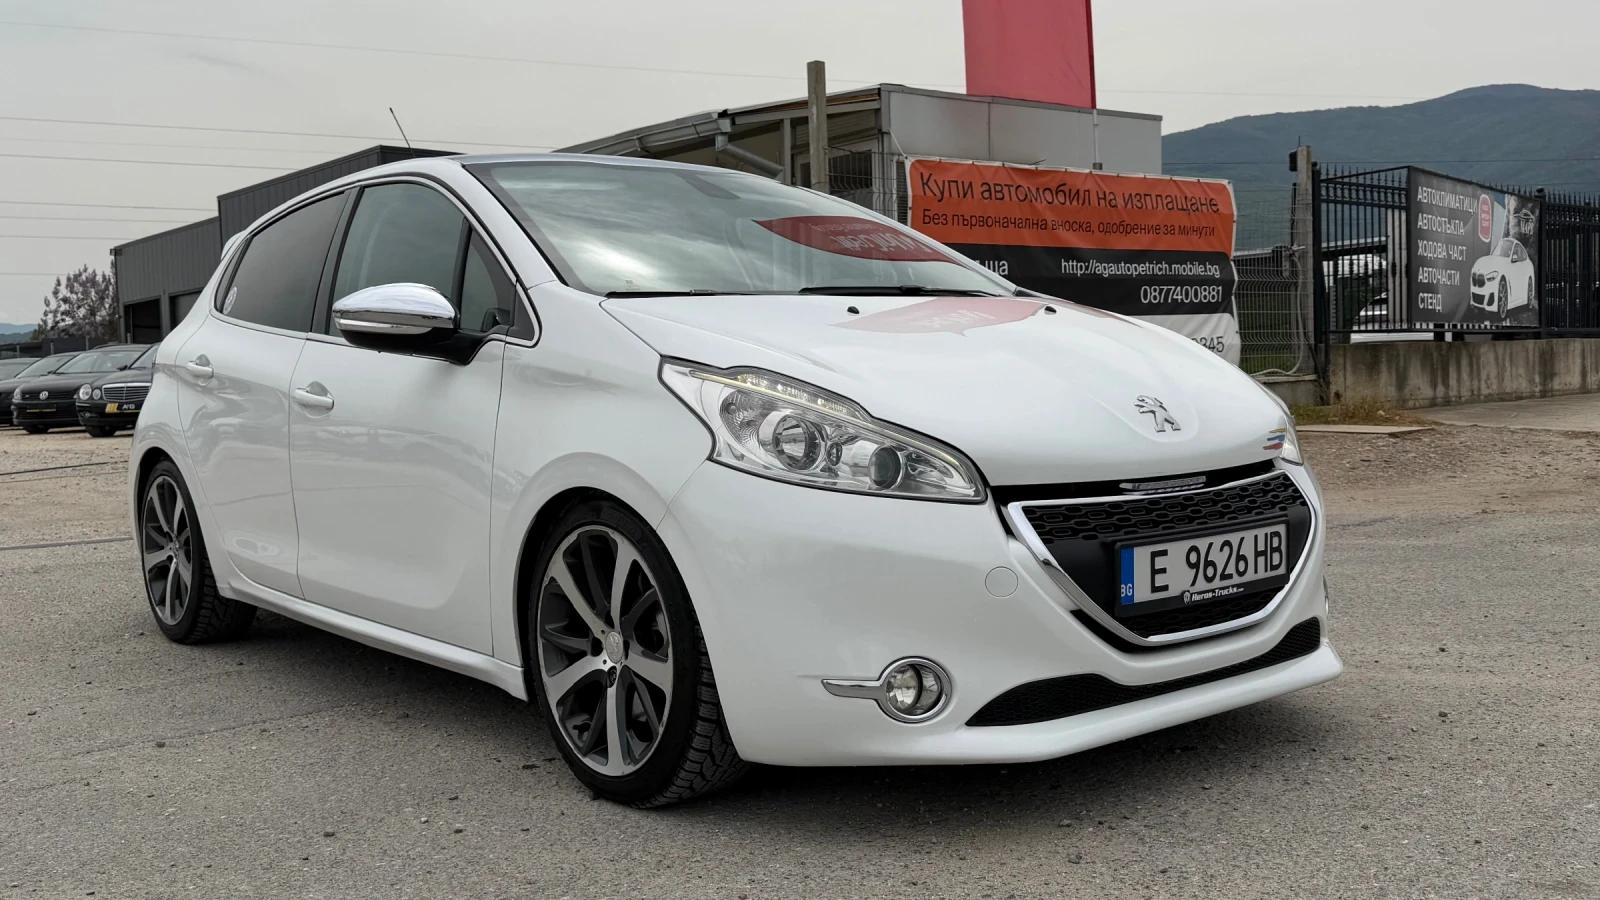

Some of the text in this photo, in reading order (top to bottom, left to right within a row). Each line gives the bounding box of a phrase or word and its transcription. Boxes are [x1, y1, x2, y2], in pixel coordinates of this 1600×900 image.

[920, 172, 1220, 215] Купи автомобил на изплащане
[1417, 186, 1478, 215] АВТОКЛИМАТИЦИ
[922, 209, 1215, 239] Без първоначална вноска, одобрение за минути
[1417, 213, 1465, 236] АВТОСТЪКЛА
[1417, 239, 1467, 262] ХОДОВА ЧАСТ
[1061, 259, 1220, 278] http://agautopetrich.mobile.bg
[1417, 266, 1460, 286] АВТОЧАСТИ
[1140, 285, 1223, 304] 0877400881
[1418, 292, 1443, 313] СТЕНД
[1191, 335, 1225, 353] 345
[1150, 530, 1283, 594] E 9626 HB
[1120, 583, 1133, 598] BG
